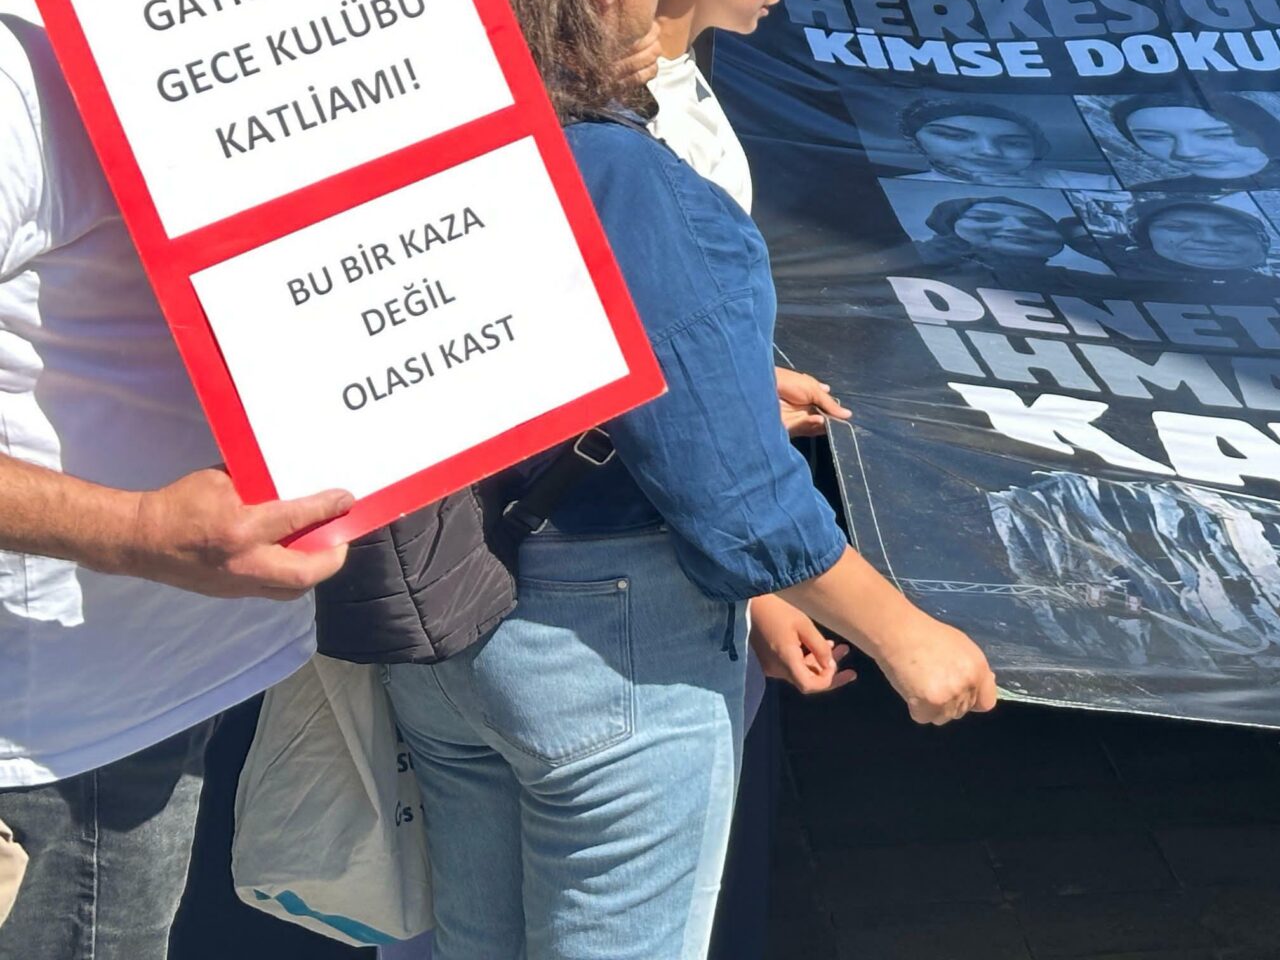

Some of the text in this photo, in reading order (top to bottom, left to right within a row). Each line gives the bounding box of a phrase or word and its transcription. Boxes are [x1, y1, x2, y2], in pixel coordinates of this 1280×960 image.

[156, 43, 261, 103] GECE
[803, 26, 1052, 78] KİMSE
[215, 57, 422, 159] KATLİAMI!
[286, 206, 486, 306] BU BİR KAZA
[361, 278, 456, 336] DEĞİL
[341, 315, 517, 411] OLASI KAST
